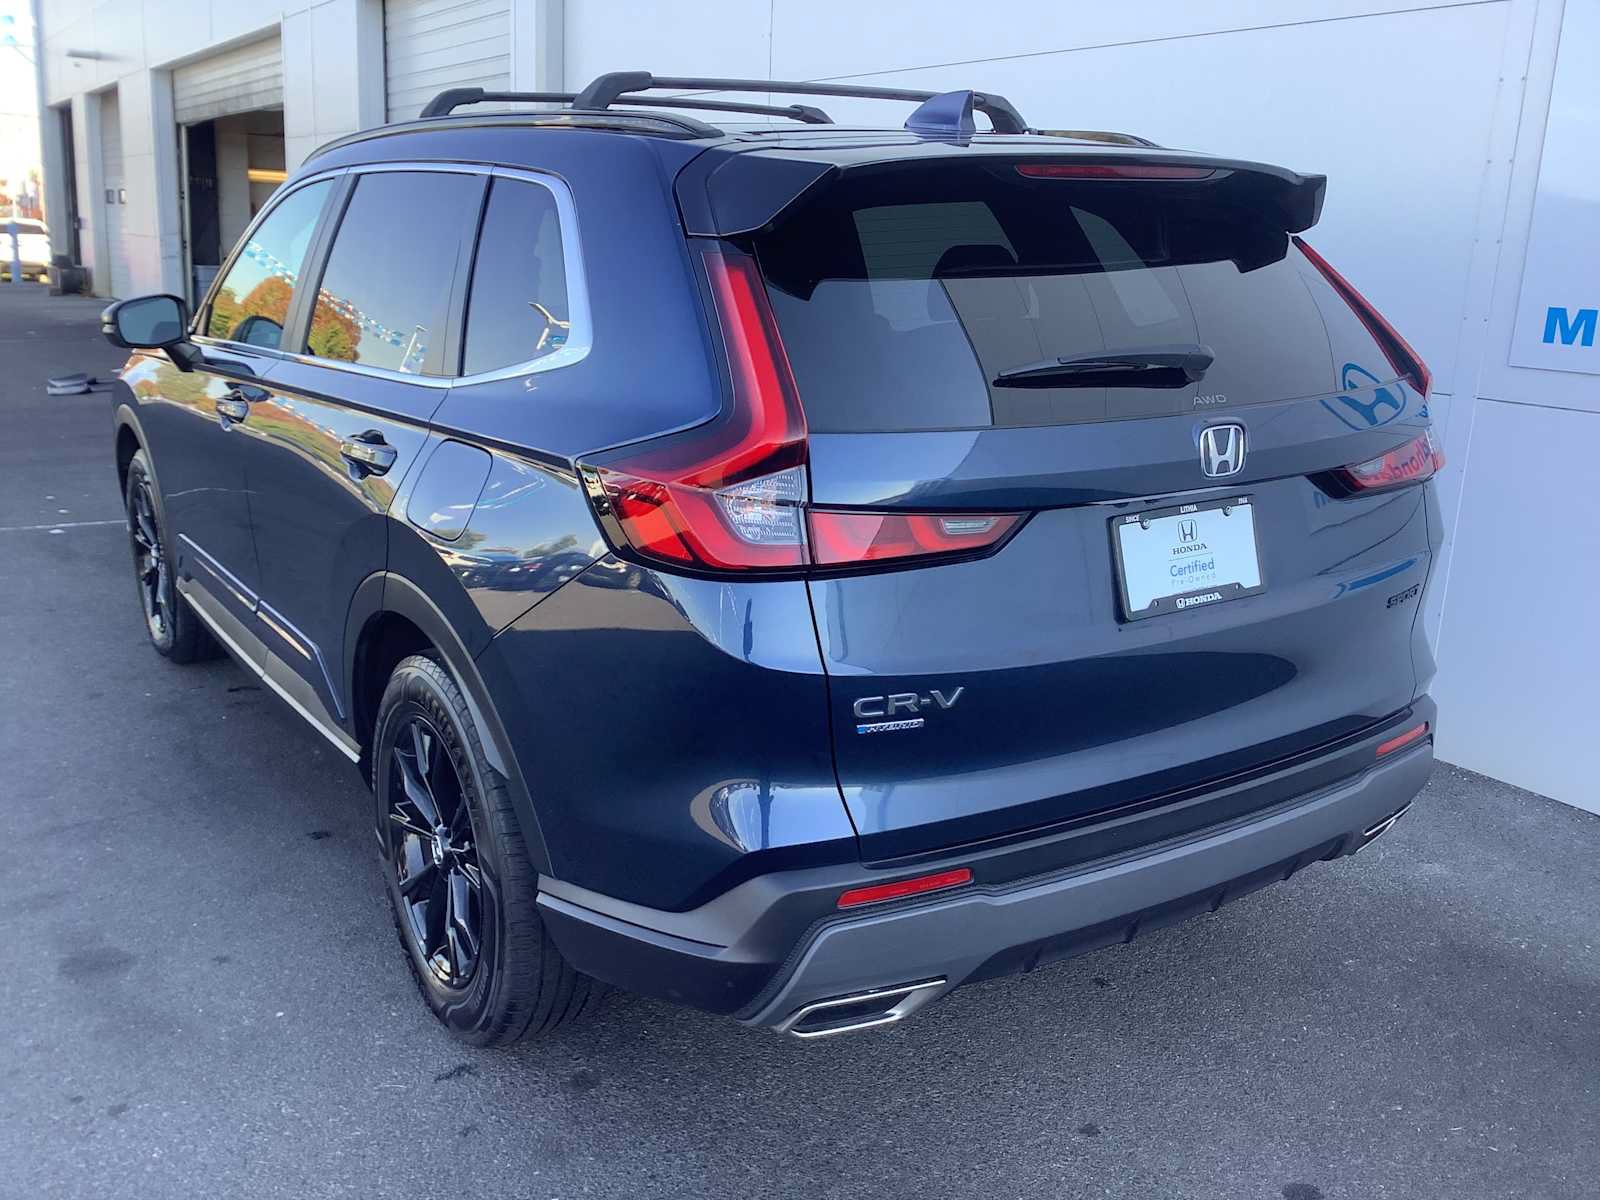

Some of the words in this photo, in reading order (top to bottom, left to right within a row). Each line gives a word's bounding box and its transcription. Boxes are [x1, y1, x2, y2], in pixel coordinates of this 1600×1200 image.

[1193, 394, 1226, 406] AWD
[1172, 542, 1208, 555] HONDA
[1170, 557, 1215, 577] Certified
[1184, 592, 1223, 607] HONDA
[853, 686, 965, 718] CR-V
